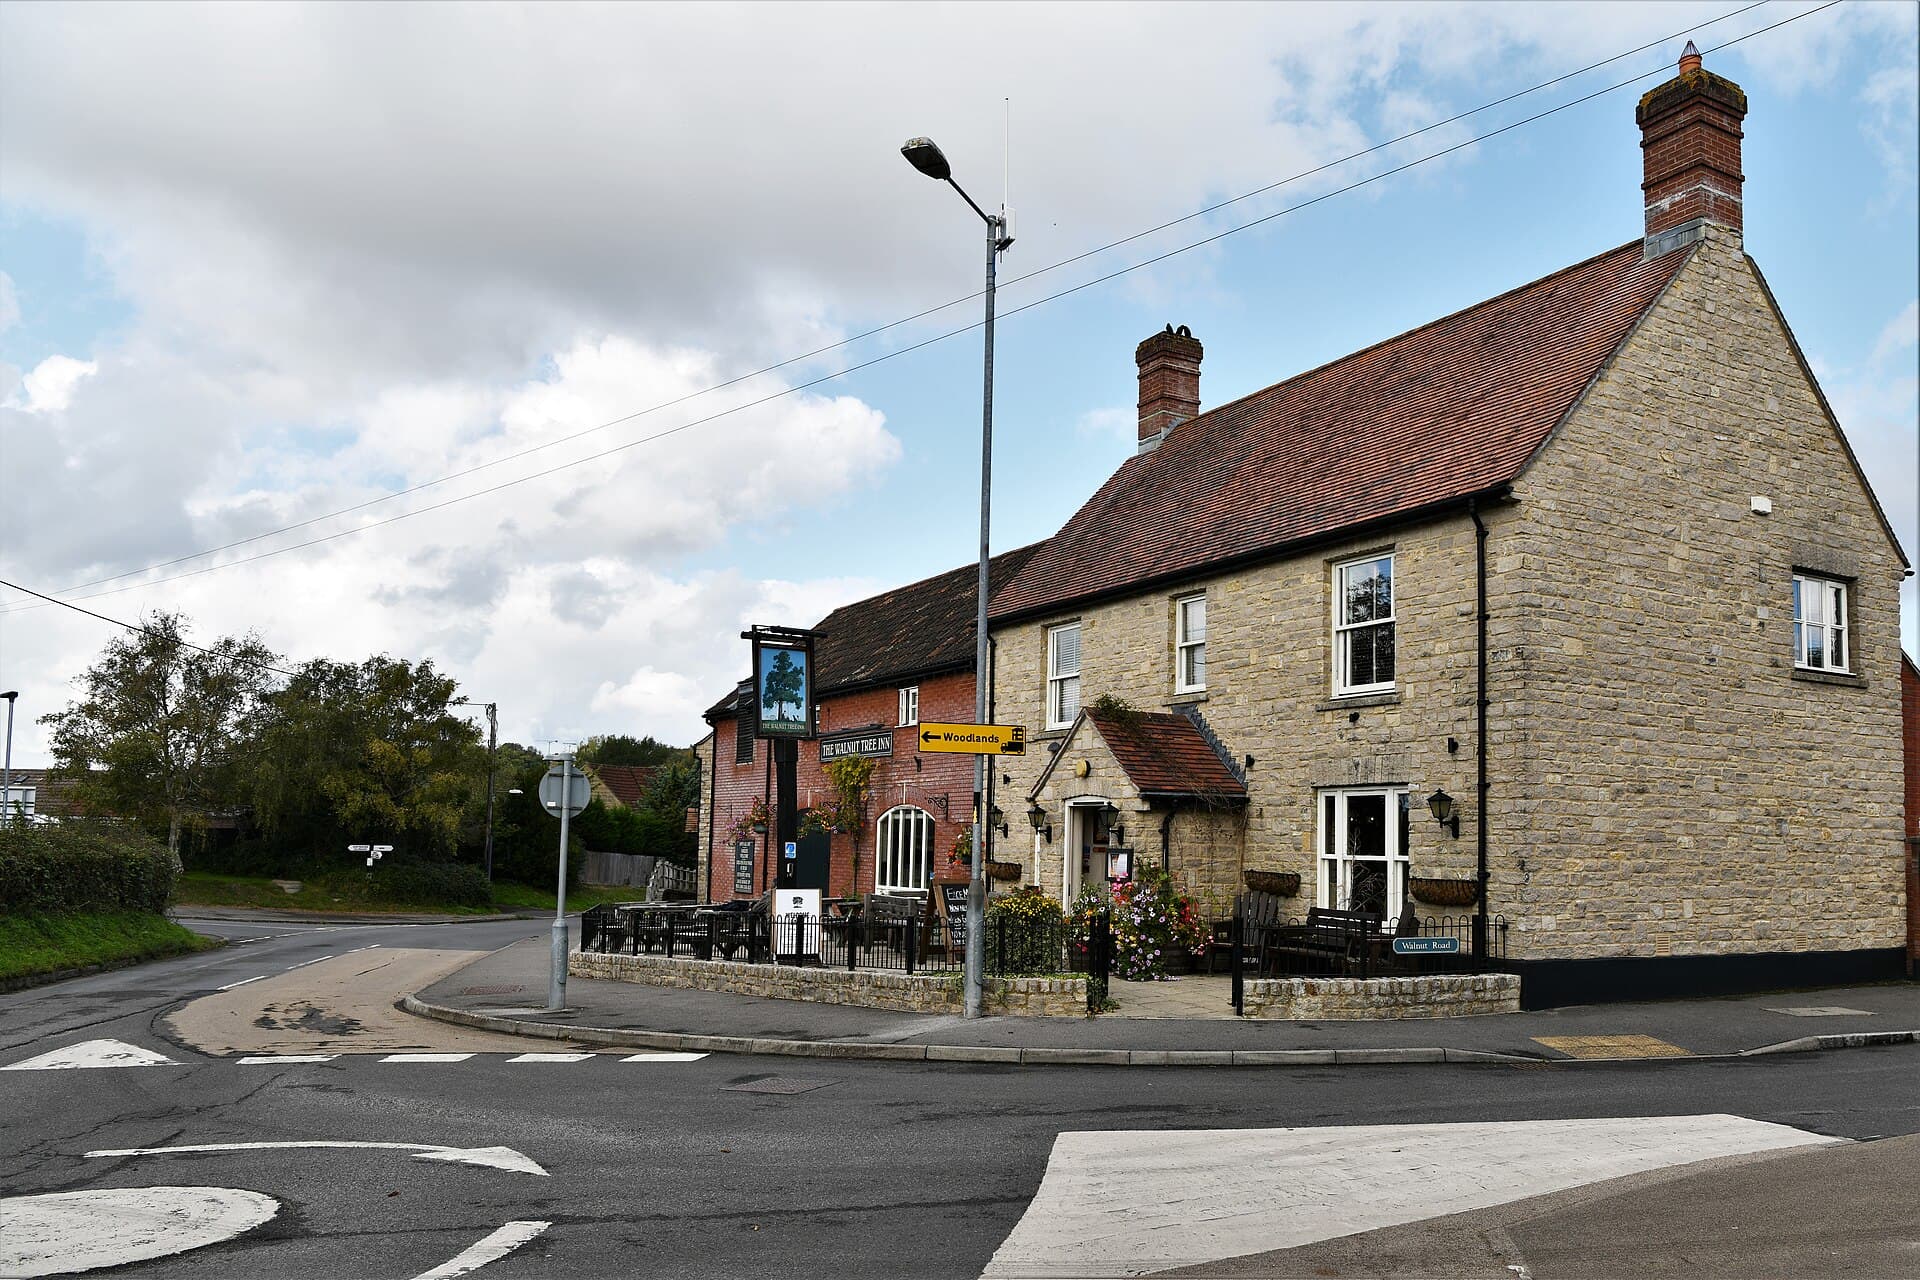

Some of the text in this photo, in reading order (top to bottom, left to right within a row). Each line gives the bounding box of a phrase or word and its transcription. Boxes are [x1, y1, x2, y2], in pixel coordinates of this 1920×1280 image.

[943, 733, 999, 743] Woodlands
[822, 737, 891, 757] THE WALNUT TREE INN
[1402, 941, 1451, 950] Walnut Road
